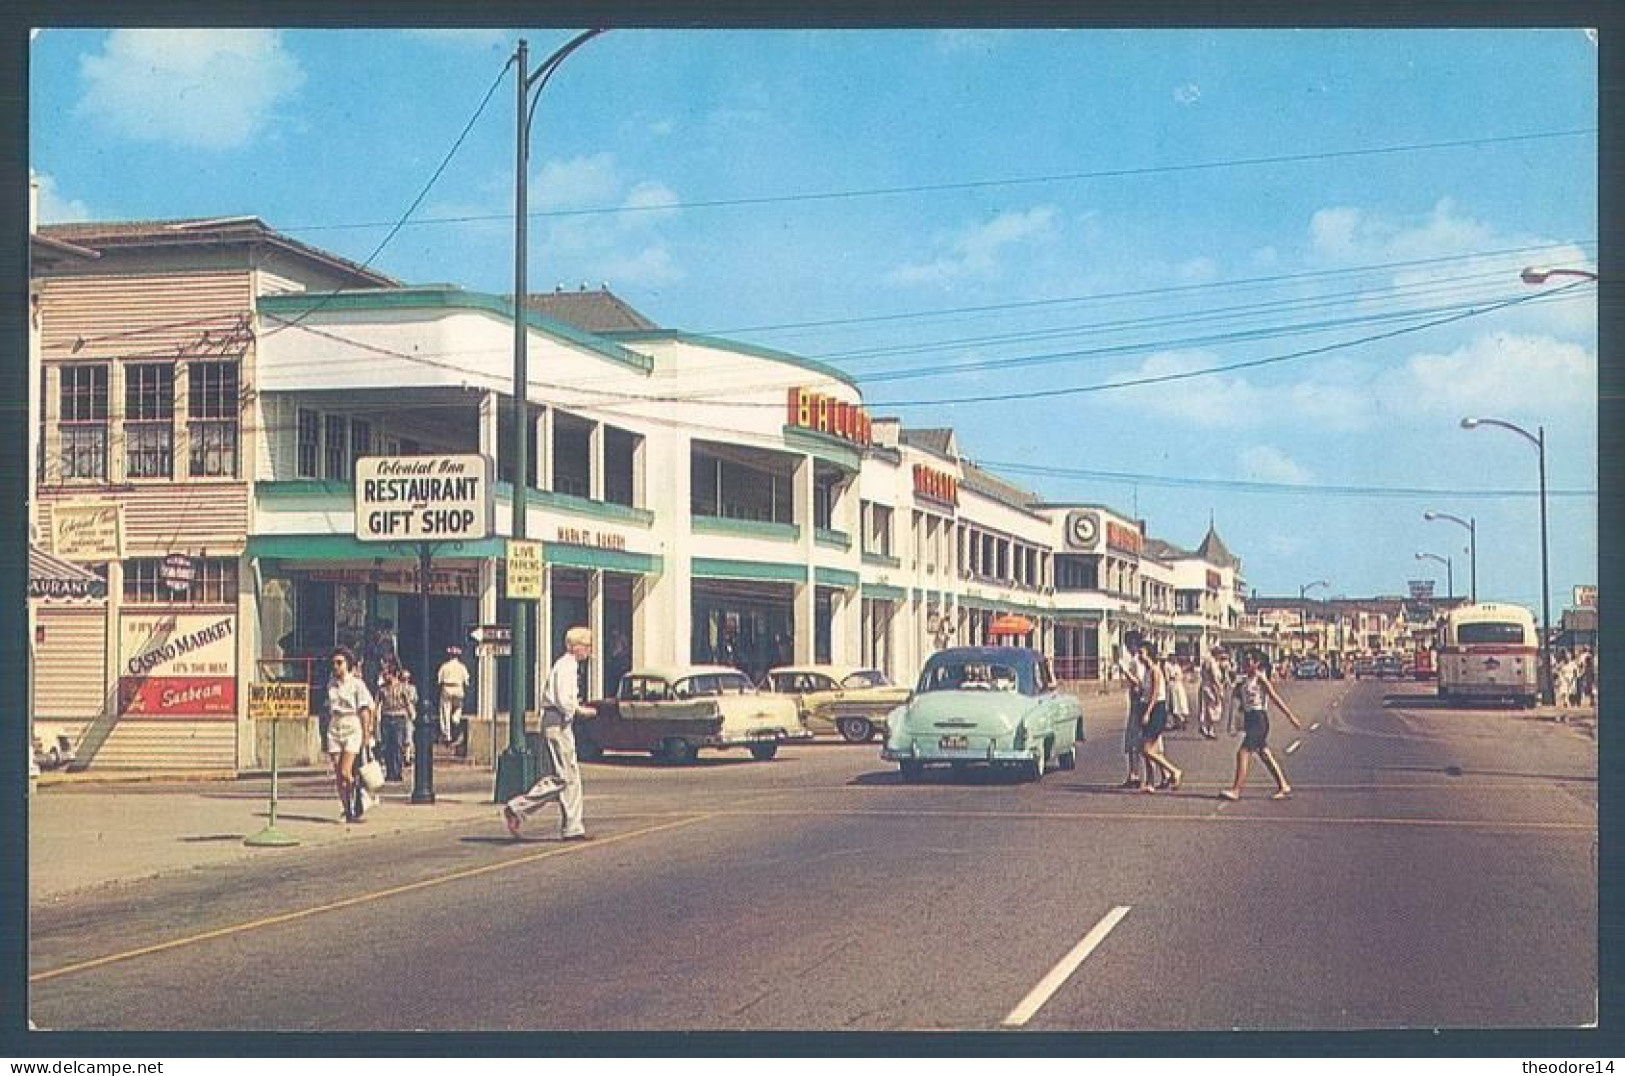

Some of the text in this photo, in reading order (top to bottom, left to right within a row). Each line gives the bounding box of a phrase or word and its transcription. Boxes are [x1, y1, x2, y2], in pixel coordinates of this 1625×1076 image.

[377, 459, 465, 475] Colonial Inn
[365, 477, 480, 502] RESTAURANT
[369, 509, 474, 534] GIFT SHOP
[513, 546, 535, 558] LIVE
[509, 560, 539, 571] PARKING
[128, 618, 232, 674] CASINO MARKET
[209, 662, 228, 673] BEST
[162, 685, 222, 707] Sunbeam
[251, 686, 307, 700] NO PARKING
